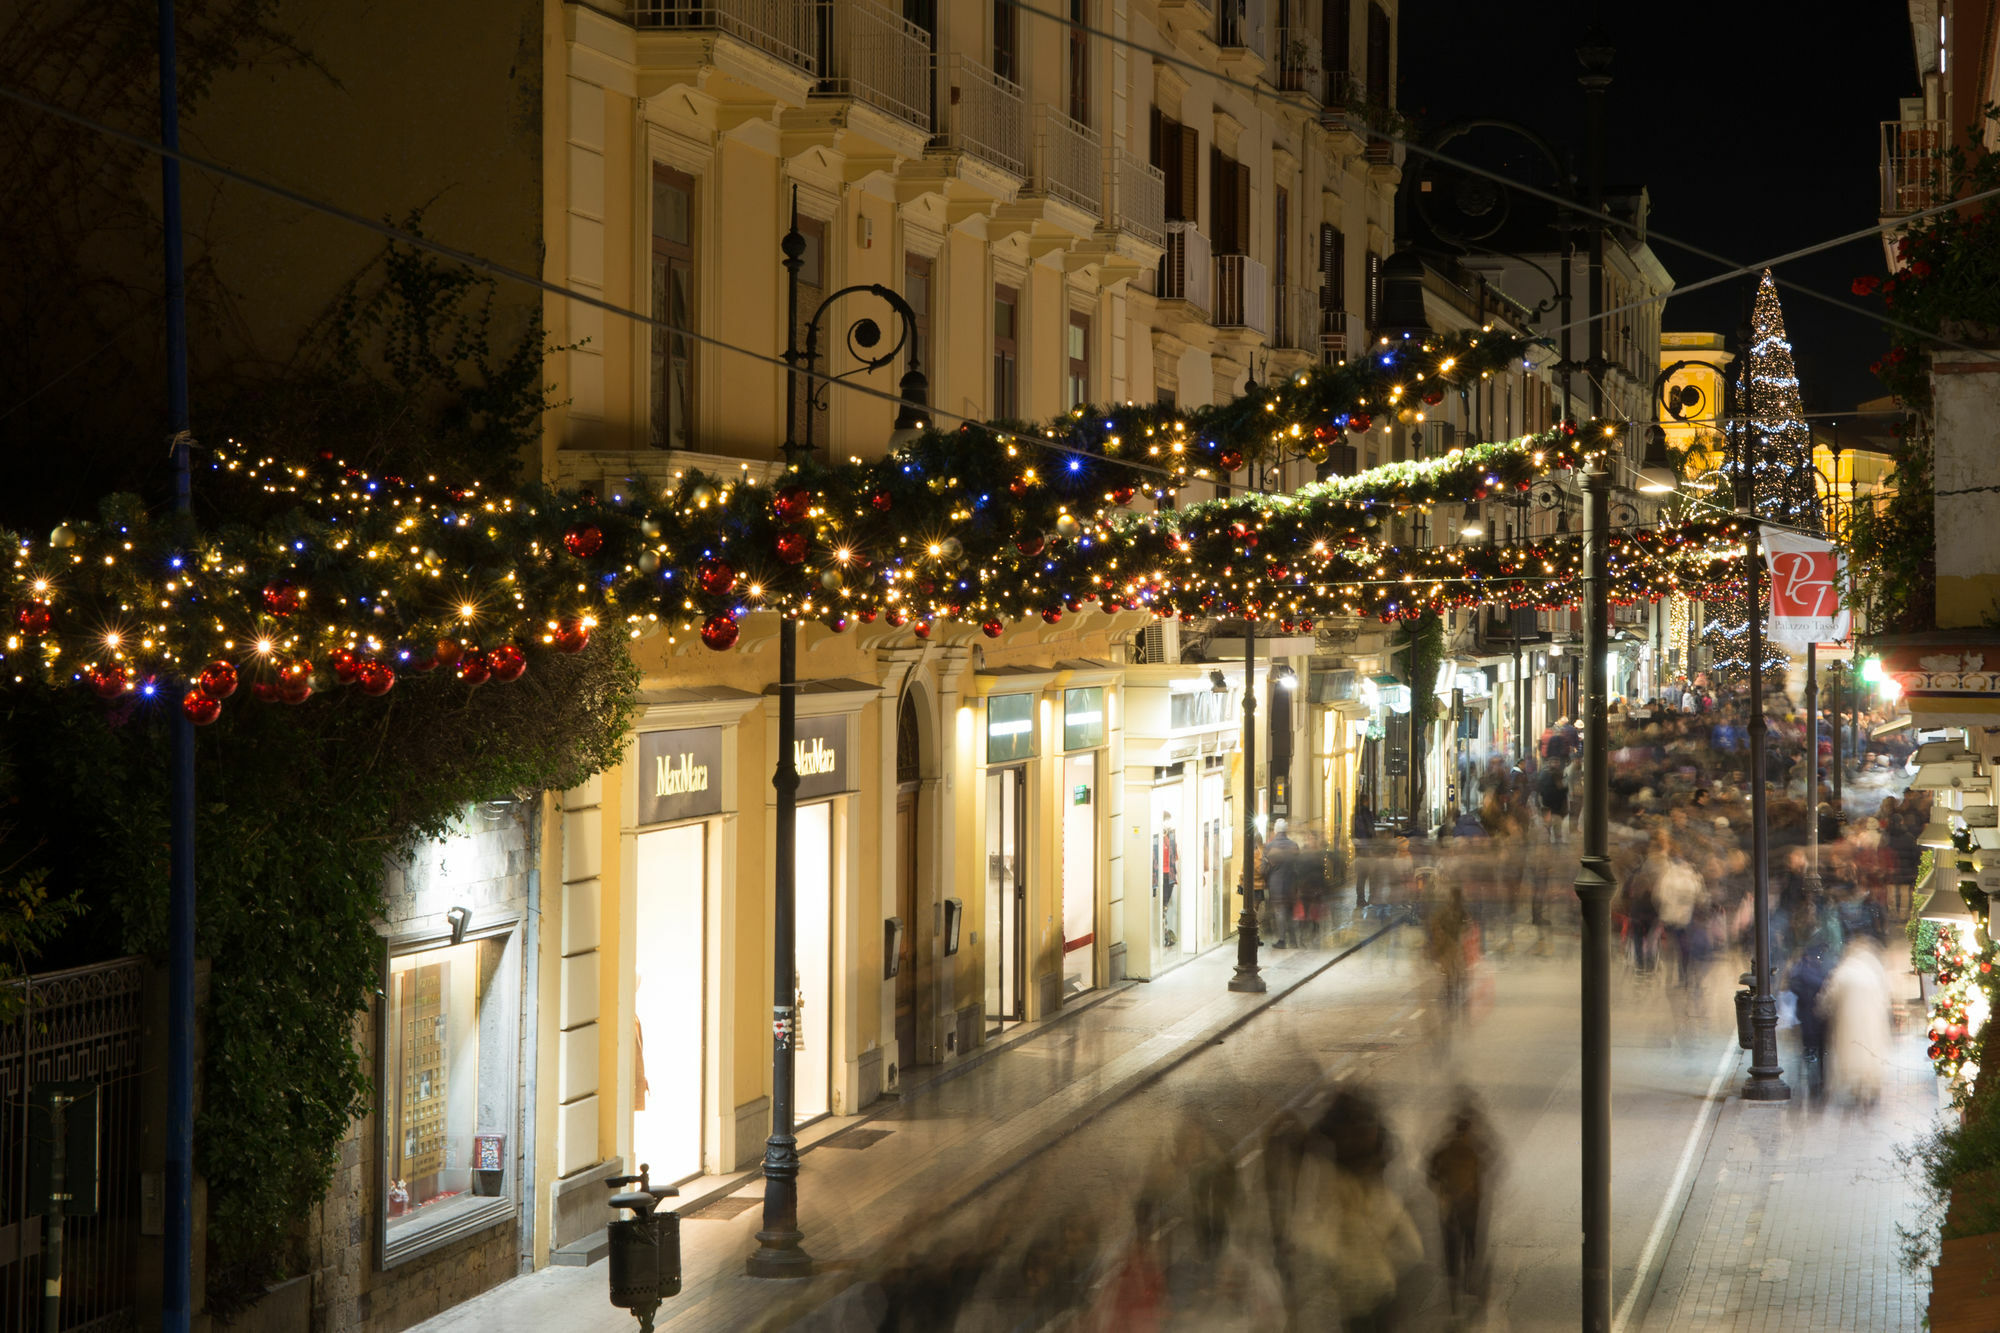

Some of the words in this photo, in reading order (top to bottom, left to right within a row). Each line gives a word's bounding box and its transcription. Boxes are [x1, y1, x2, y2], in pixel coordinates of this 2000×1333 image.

[1775, 620, 1809, 631] Palazzo
[1814, 620, 1839, 631] Tasso
[656, 752, 708, 797] MaxMara
[794, 737, 835, 776] MaxMara
